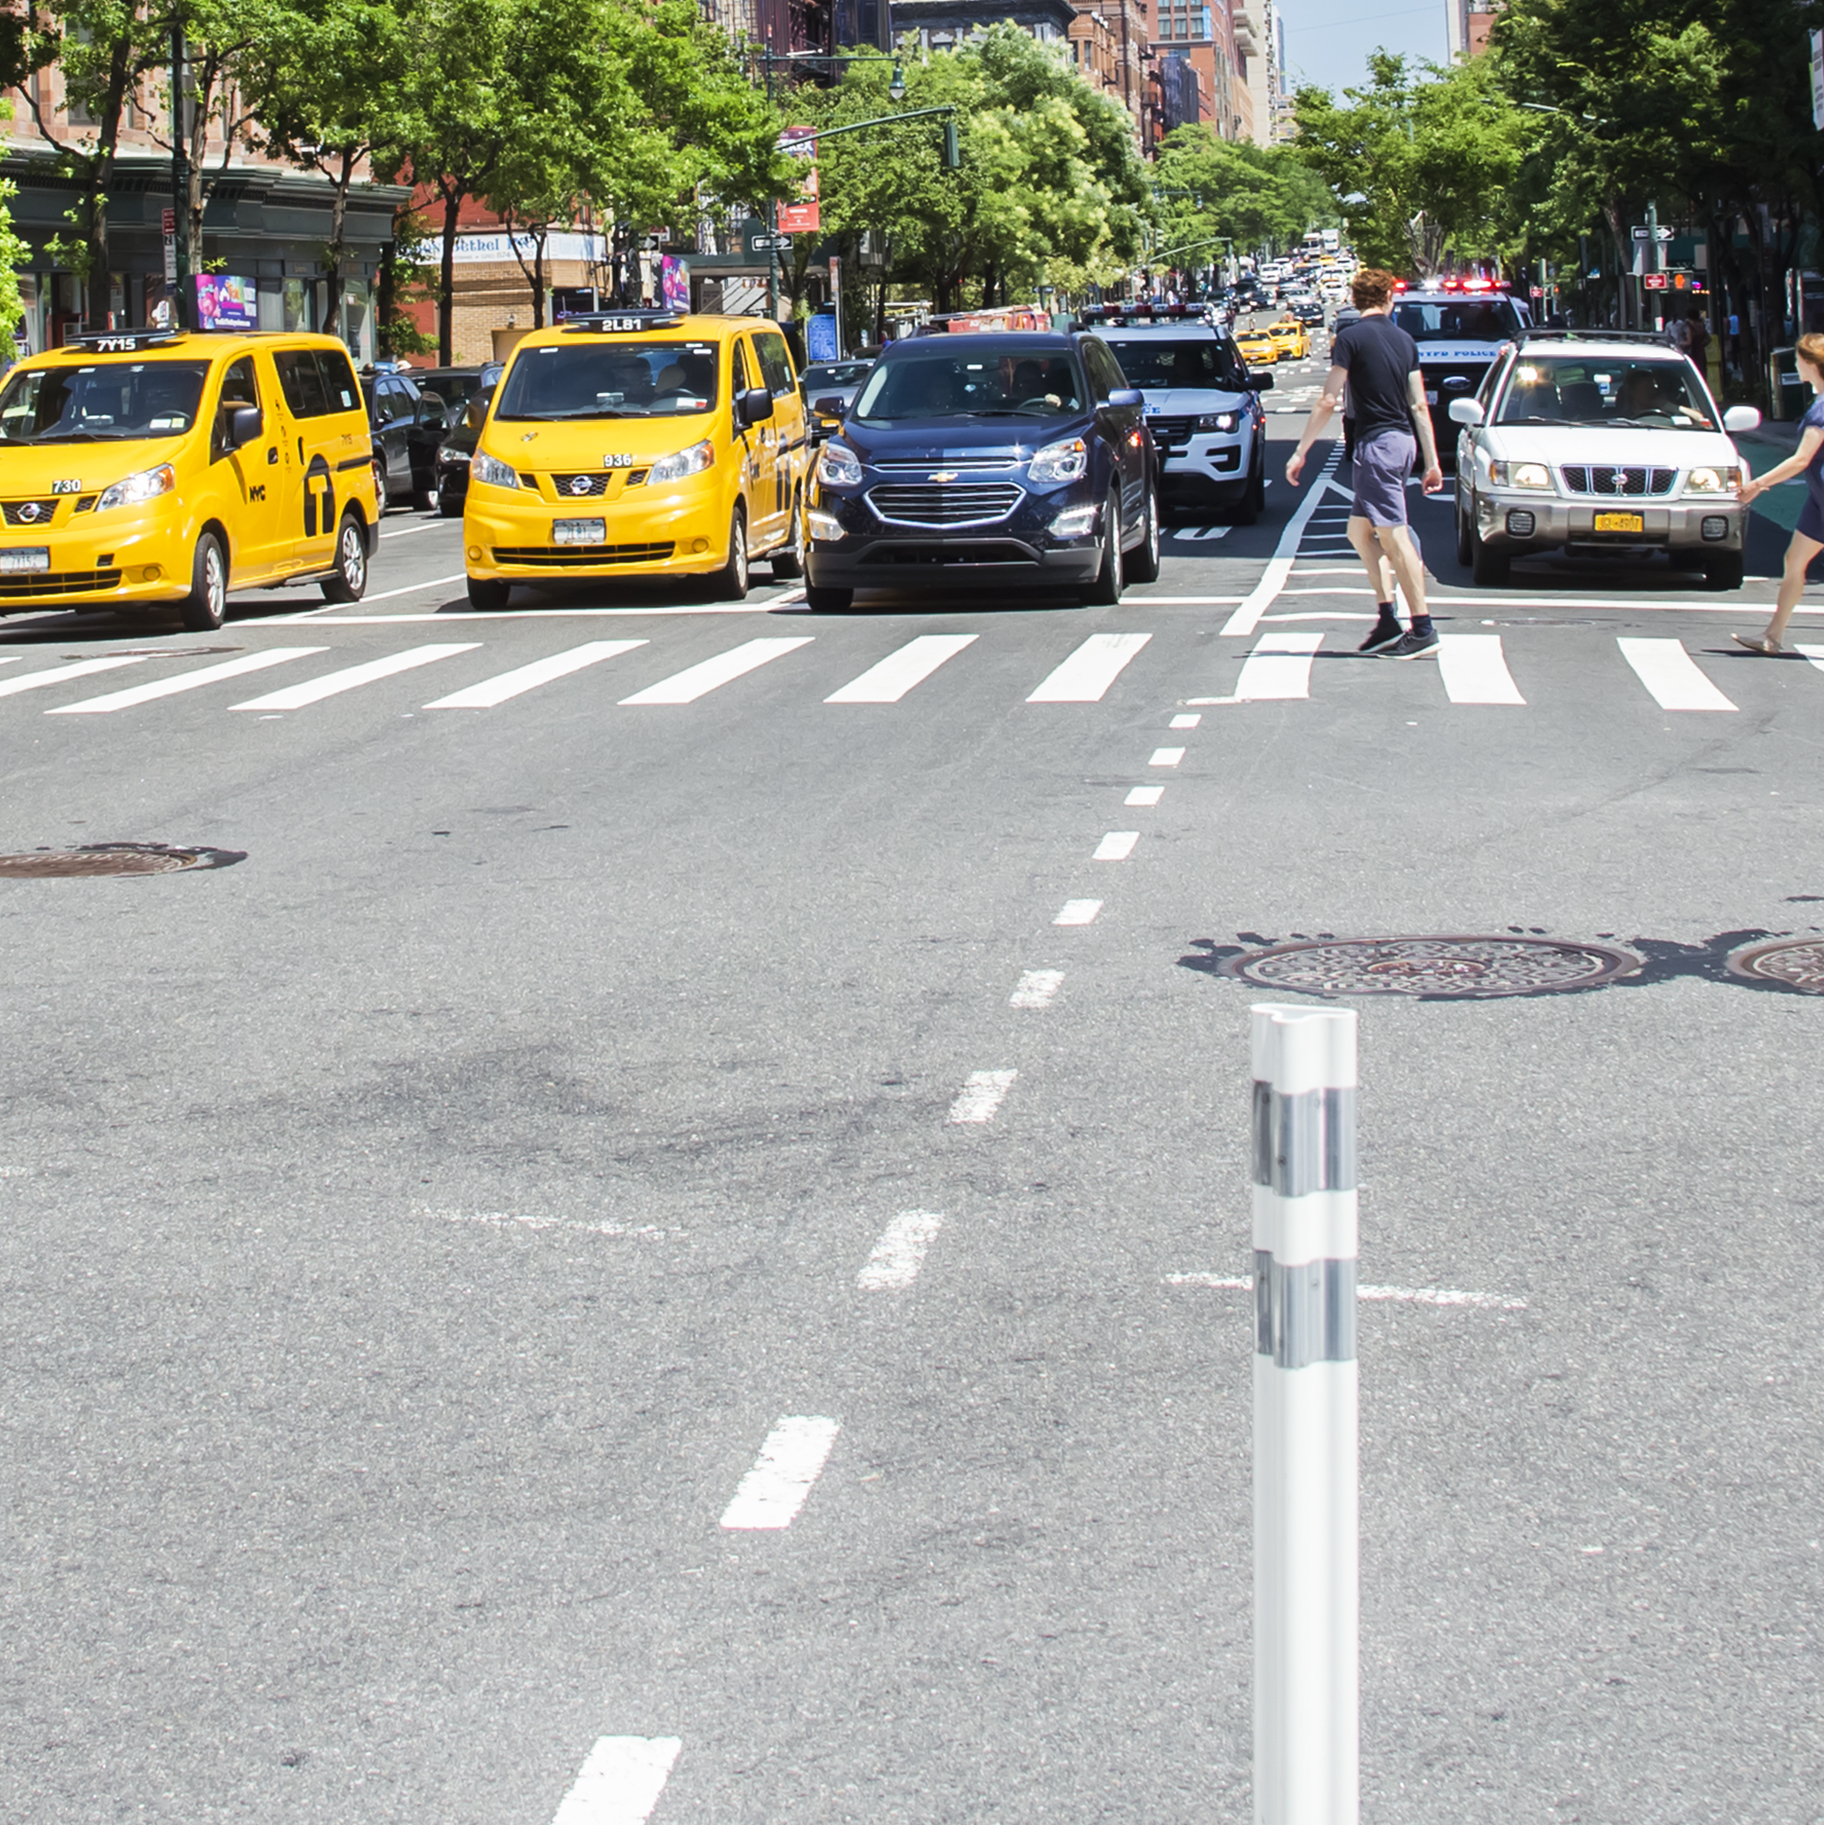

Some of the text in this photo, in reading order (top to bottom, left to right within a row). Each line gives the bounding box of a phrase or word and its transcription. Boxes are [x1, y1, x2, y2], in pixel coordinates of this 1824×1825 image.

[602, 318, 642, 332] 2L81
[96, 338, 137, 352] 7Y15
[1453, 349, 1497, 358] POLICE
[603, 453, 632, 468] 936
[52, 478, 82, 494] 730
[249, 484, 266, 503] NYC
